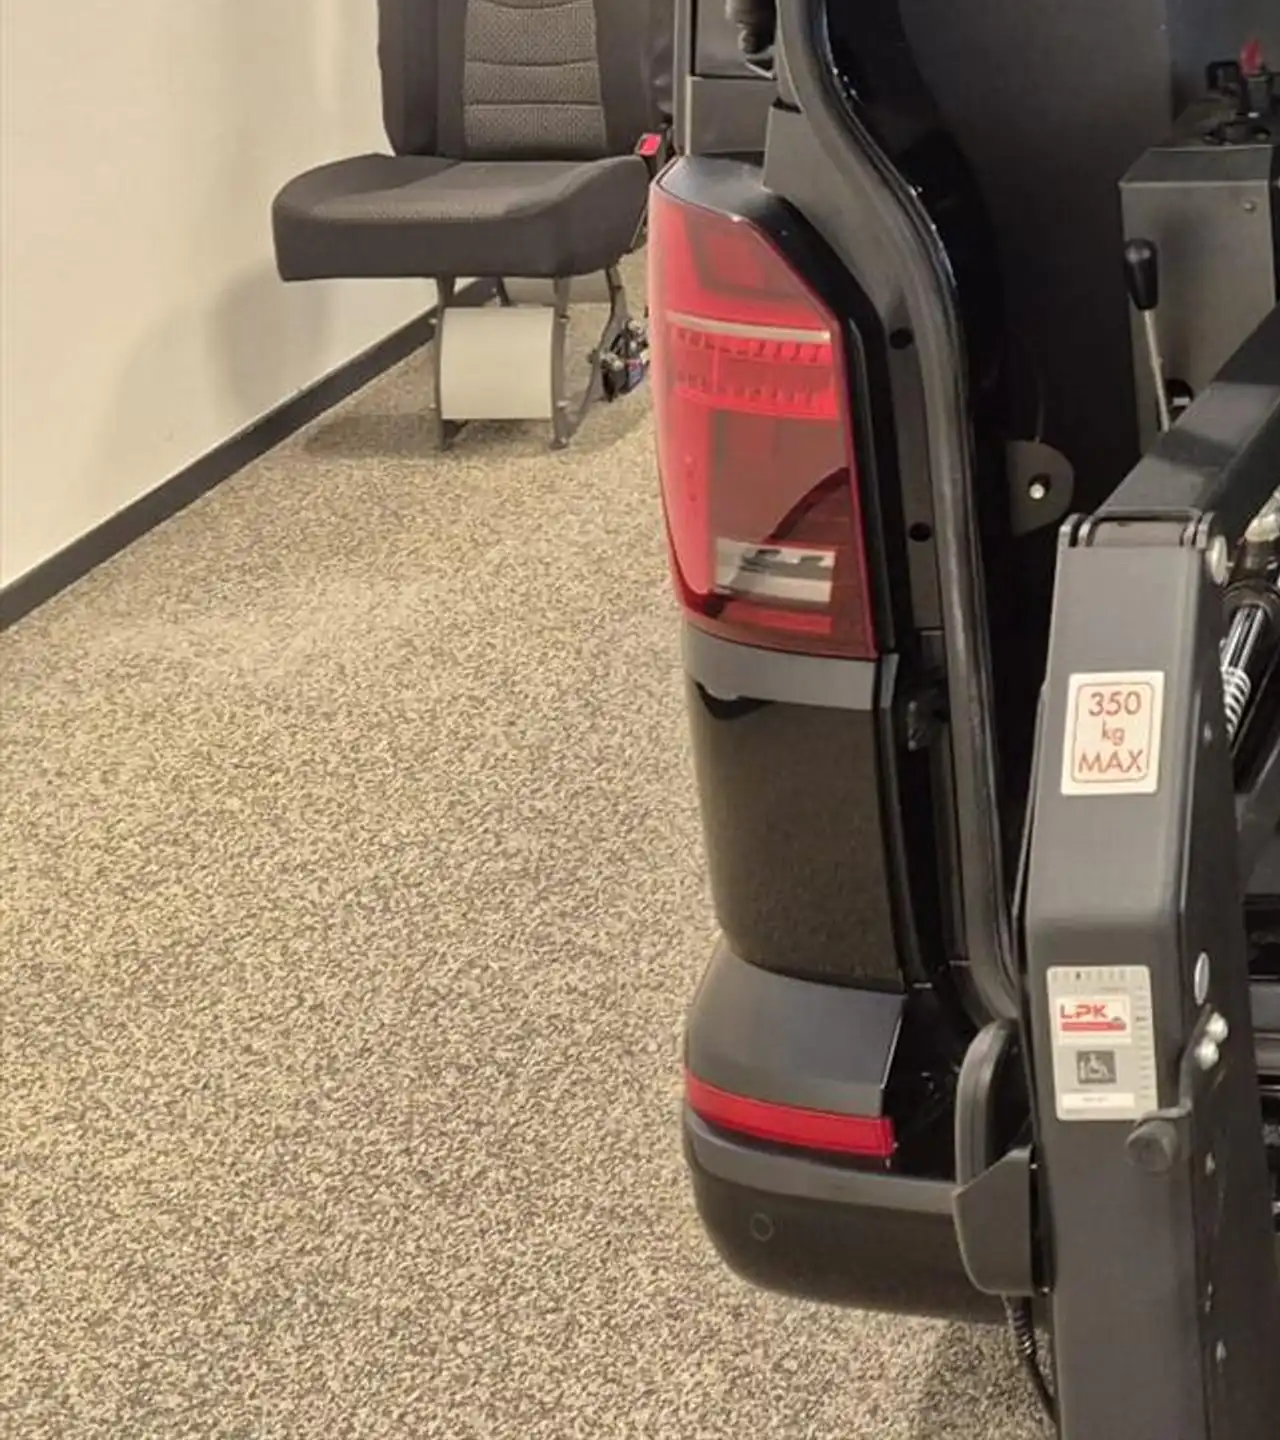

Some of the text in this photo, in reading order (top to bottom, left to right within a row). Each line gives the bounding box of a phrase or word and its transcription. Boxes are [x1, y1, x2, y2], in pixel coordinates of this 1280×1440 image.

[1088, 690, 1142, 717] 350
[1101, 718, 1125, 747] kg
[1078, 750, 1144, 775] MAX
[1060, 1003, 1109, 1020] LPK
